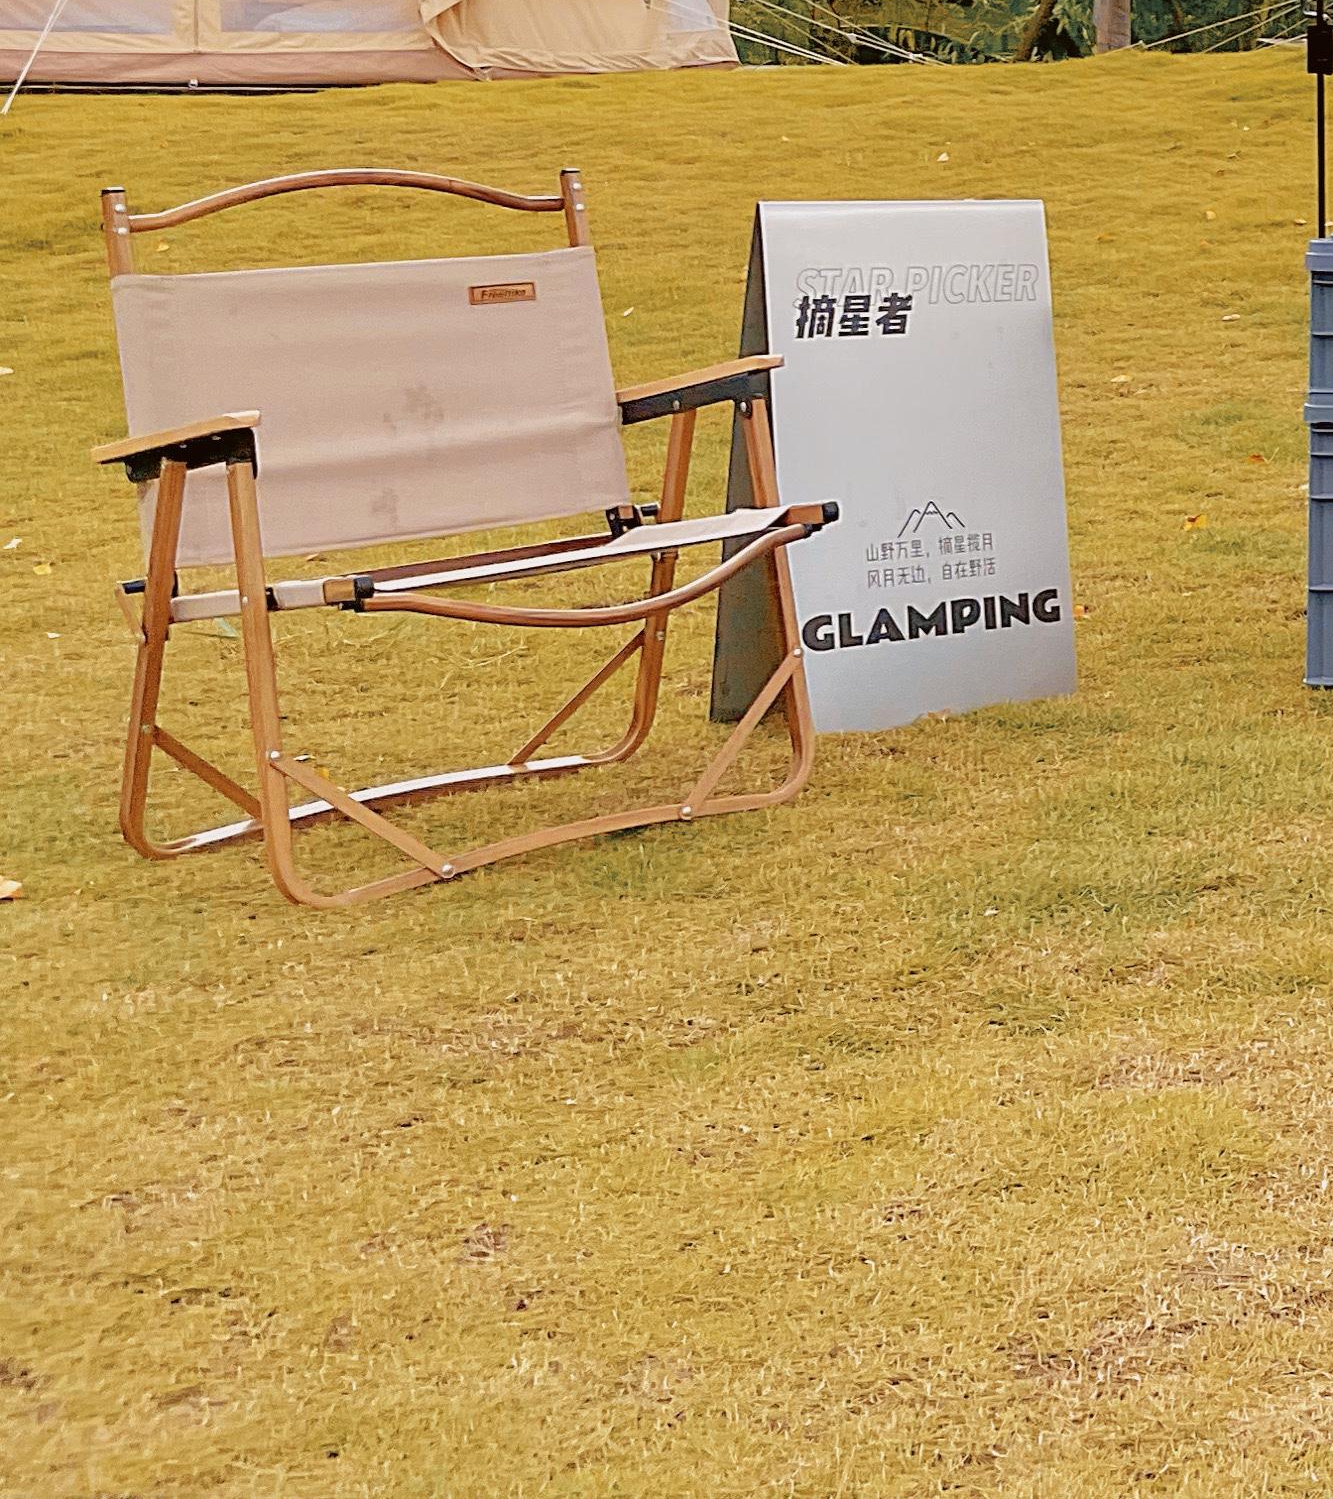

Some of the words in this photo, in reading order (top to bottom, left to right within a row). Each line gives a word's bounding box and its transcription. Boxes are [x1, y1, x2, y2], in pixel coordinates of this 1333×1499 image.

[793, 267, 895, 310] STAR
[904, 264, 1040, 305] PICKER
[795, 292, 913, 339] 摘星者
[802, 588, 1061, 652] GLAMPING
